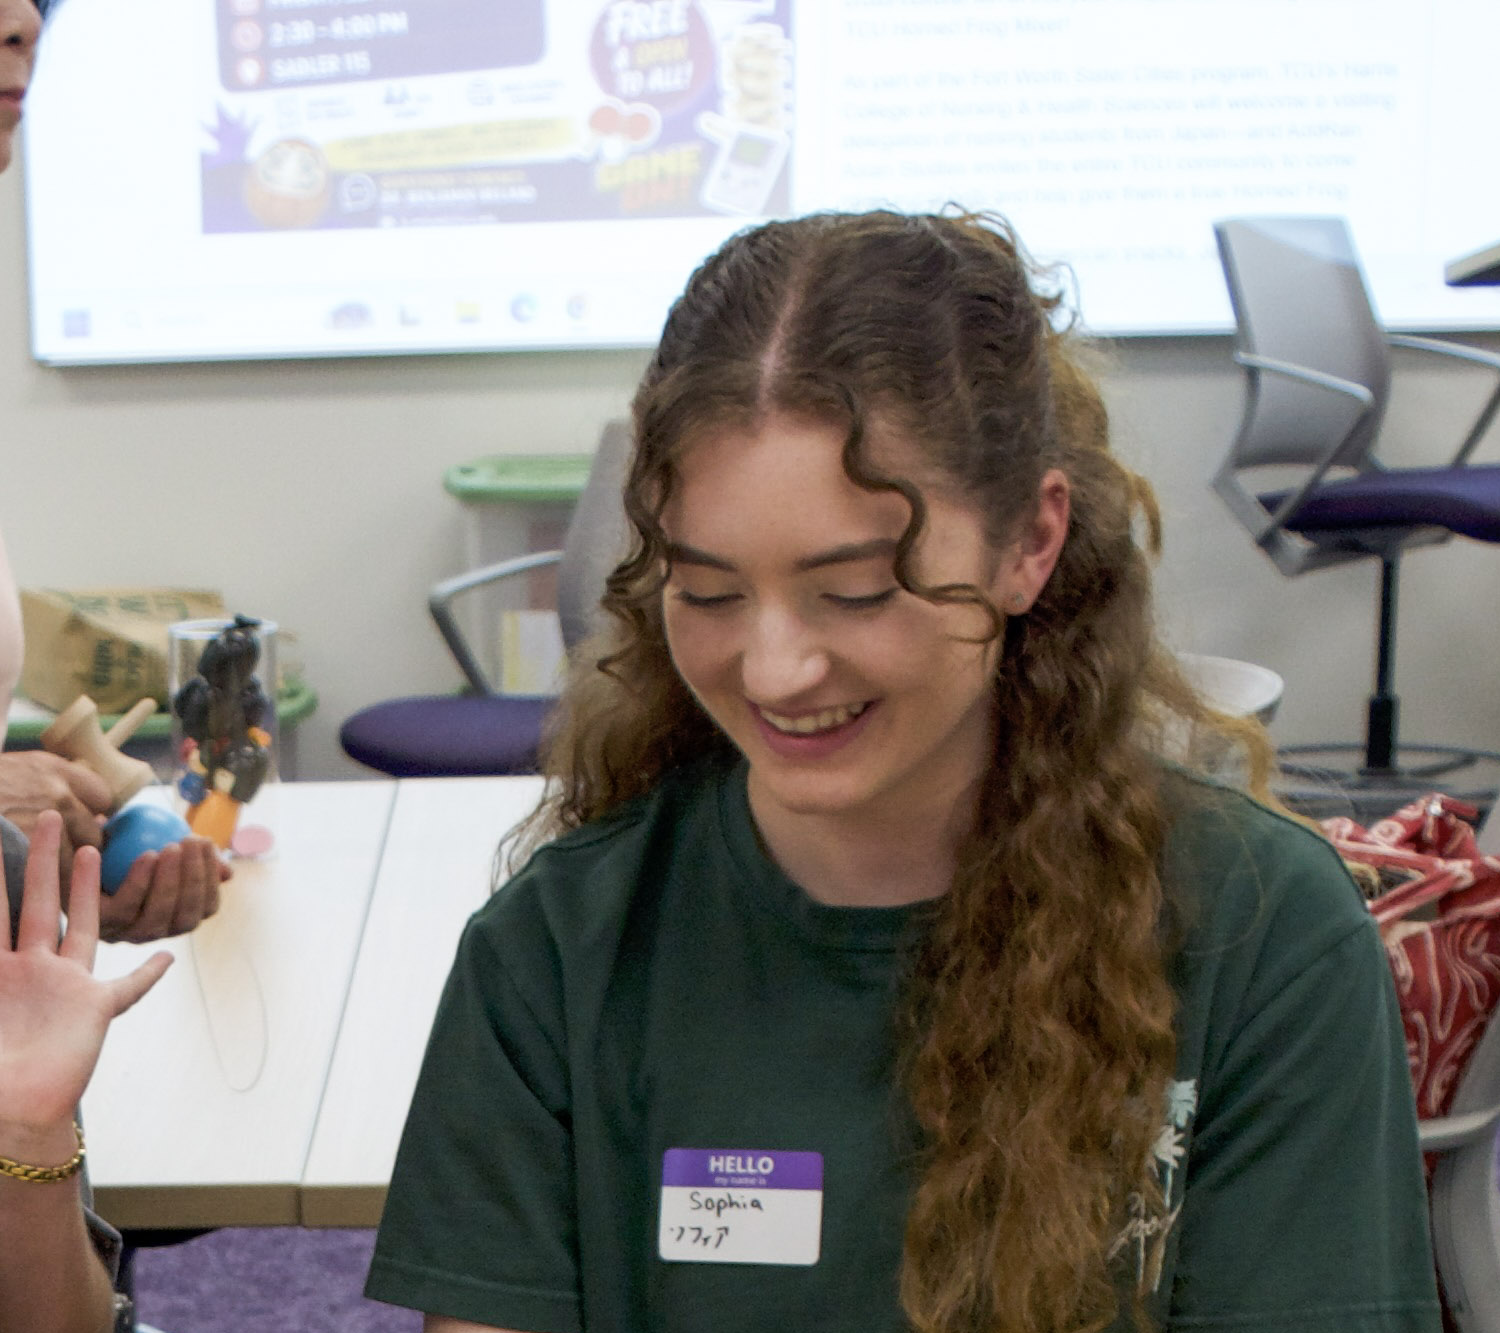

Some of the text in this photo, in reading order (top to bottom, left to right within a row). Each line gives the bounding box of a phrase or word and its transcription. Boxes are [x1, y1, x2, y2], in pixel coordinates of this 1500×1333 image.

[377, 11, 409, 37] PM
[602, 0, 690, 46] FREE
[893, 19, 959, 36] Horned
[965, 17, 1008, 39] Frog
[632, 35, 691, 68] OPEN
[270, 53, 342, 83] SADLER
[872, 73, 908, 93] part
[913, 71, 934, 88] of
[937, 70, 966, 87] the
[971, 68, 1009, 86] Fort
[1015, 68, 1069, 85] Worth
[1074, 66, 1127, 84] Sister
[1134, 65, 1184, 83] Cities
[1344, 60, 1399, 78] Harris
[618, 67, 645, 98] TO
[842, 102, 913, 122] College
[919, 101, 936, 118] of
[942, 100, 1013, 120] Nursing
[1038, 98, 1095, 114] Health
[1103, 97, 1187, 113] Sciences
[1191, 95, 1222, 111] will
[1226, 95, 1310, 111] welcome
[1333, 92, 1397, 112] visiting
[841, 133, 932, 153] delegation
[943, 132, 961, 147] of
[965, 130, 1034, 150] nursing
[1039, 128, 1117, 144] students
[1122, 127, 1166, 143] from
[594, 146, 703, 192] GAME
[901, 160, 966, 177] Studies
[1037, 158, 1066, 173] the
[1071, 156, 1125, 173] entire
[1175, 153, 1277, 173] community
[1281, 153, 1299, 168] to
[1304, 154, 1358, 168] come
[406, 187, 477, 204] BENJAMIN
[478, 184, 539, 202] IRELAND
[995, 189, 1029, 204] and
[1033, 187, 1074, 207] help
[1079, 187, 1117, 207] give
[1121, 185, 1168, 201] them
[1190, 185, 1227, 201] true
[1232, 183, 1300, 199] Horned
[1305, 181, 1350, 203] Frog
[708, 1155, 775, 1175] HELLO
[714, 1176, 728, 1187] my
[730, 1175, 757, 1185] name
[689, 1191, 765, 1218] Sophia
